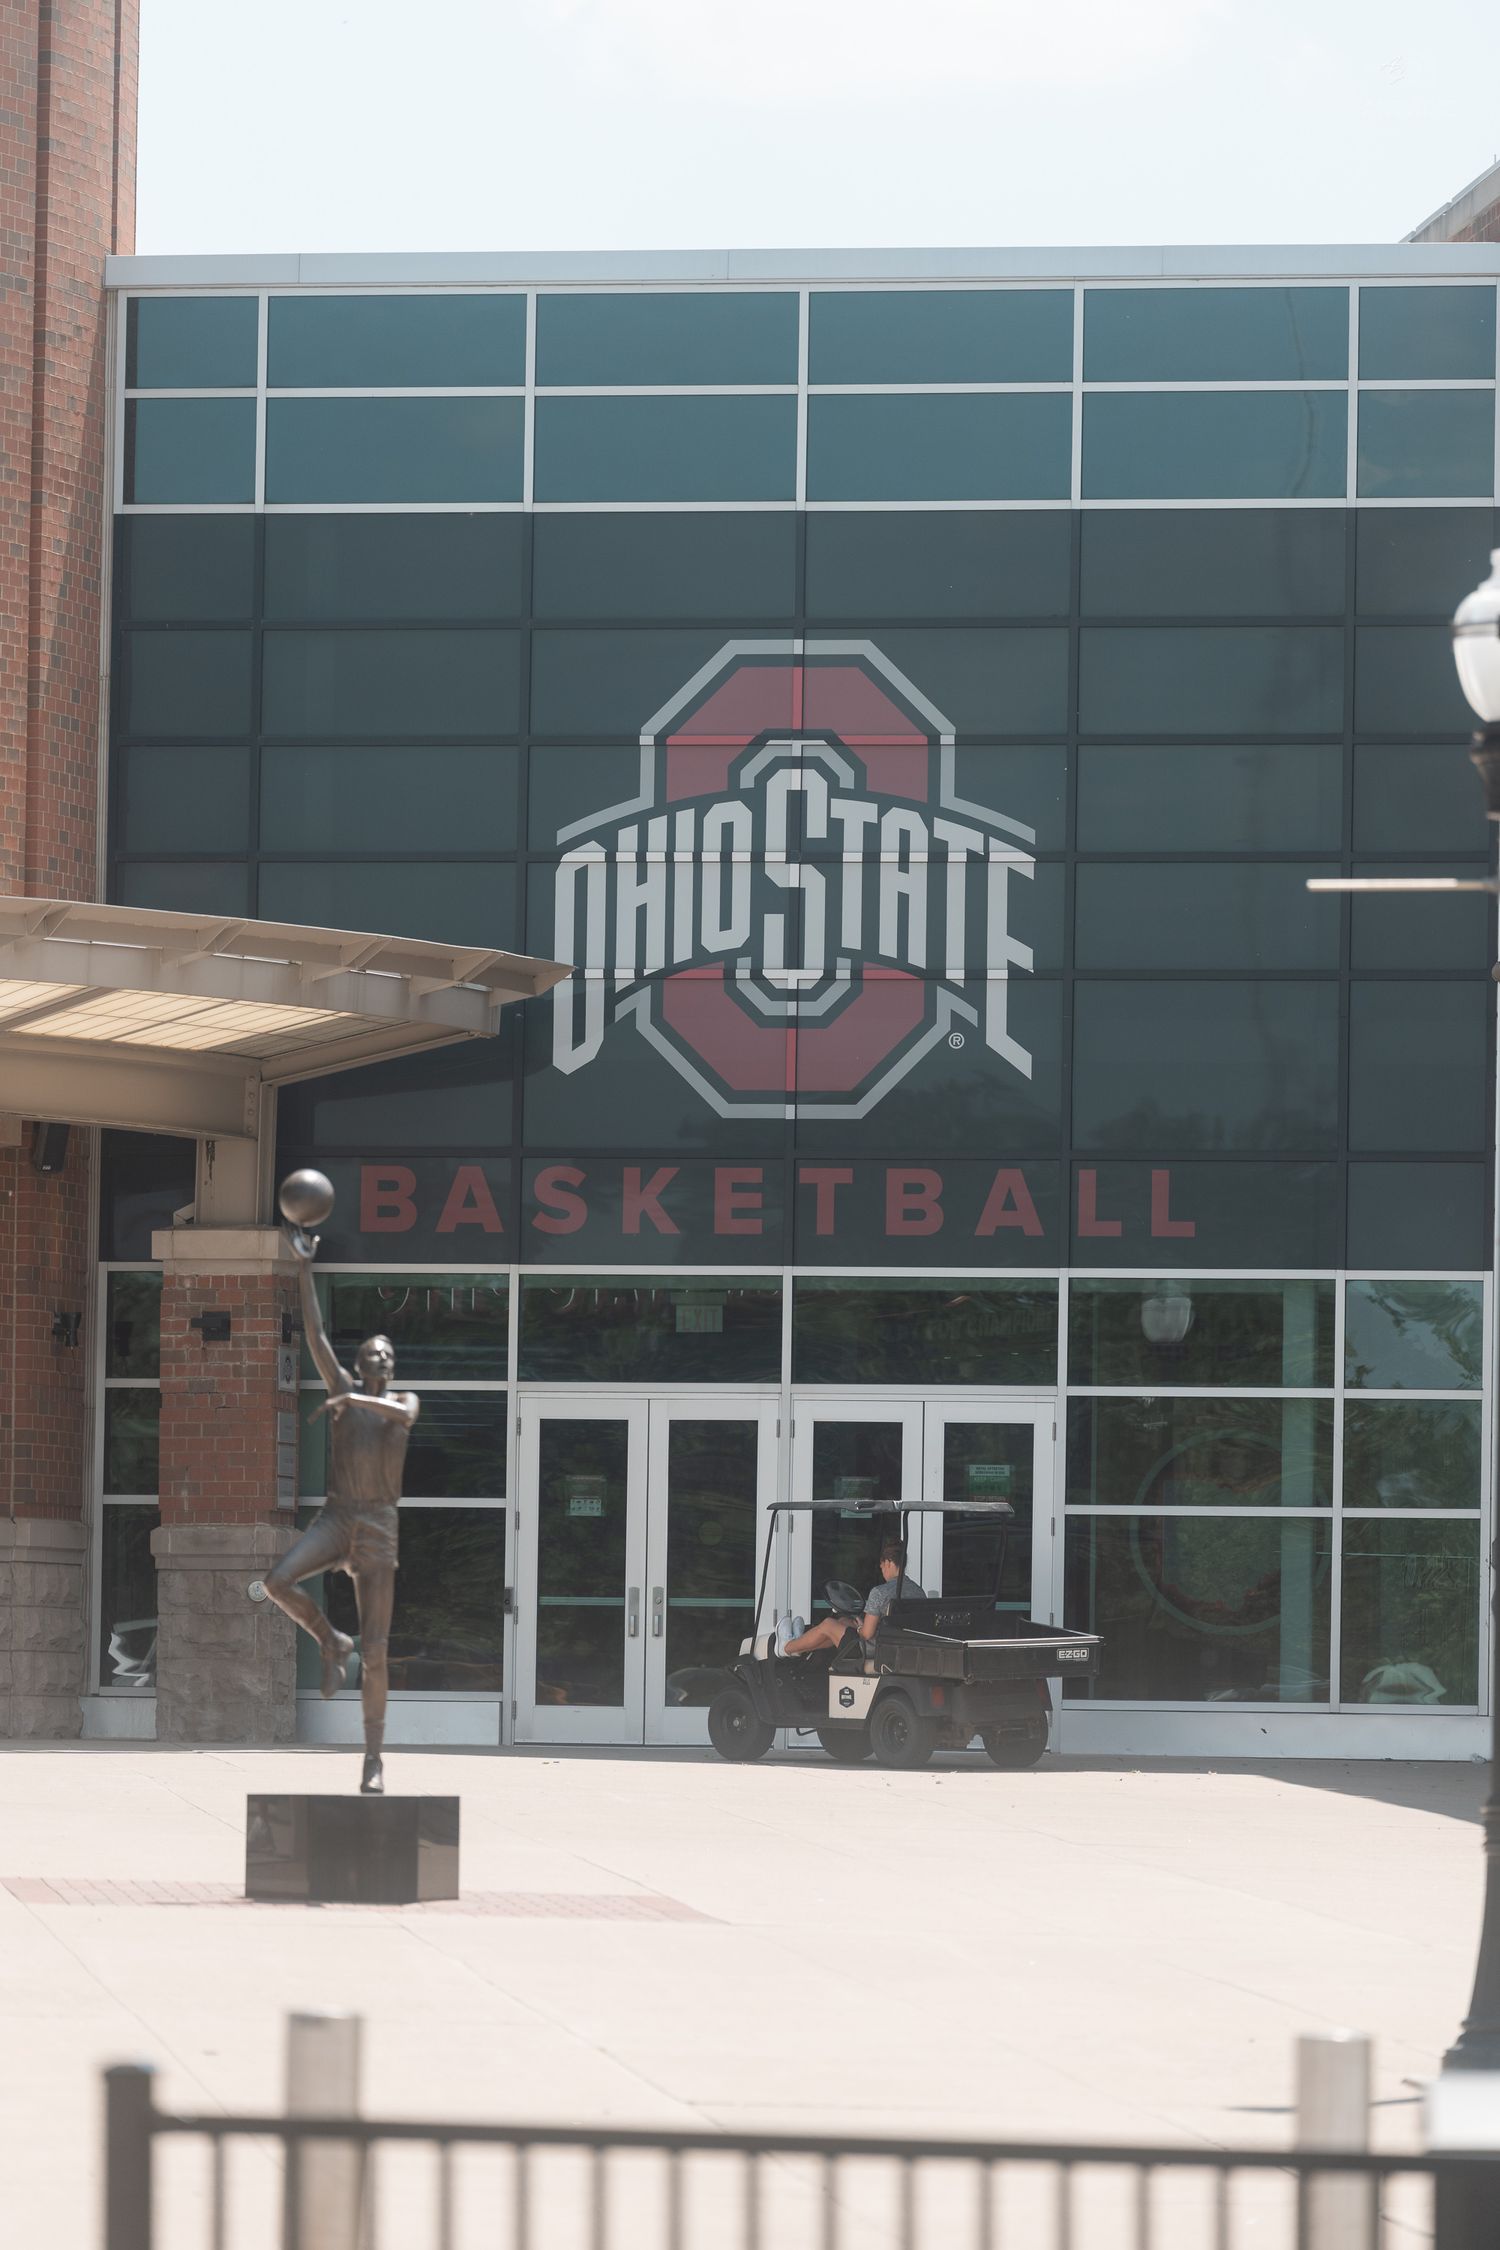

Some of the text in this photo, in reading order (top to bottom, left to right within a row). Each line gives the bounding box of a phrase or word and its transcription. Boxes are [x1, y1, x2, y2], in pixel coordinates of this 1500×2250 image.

[553, 769, 1036, 1080] OHIO STATE
[359, 1165, 1196, 1239] BASKETBALL
[682, 1308, 719, 1331] EXIT
